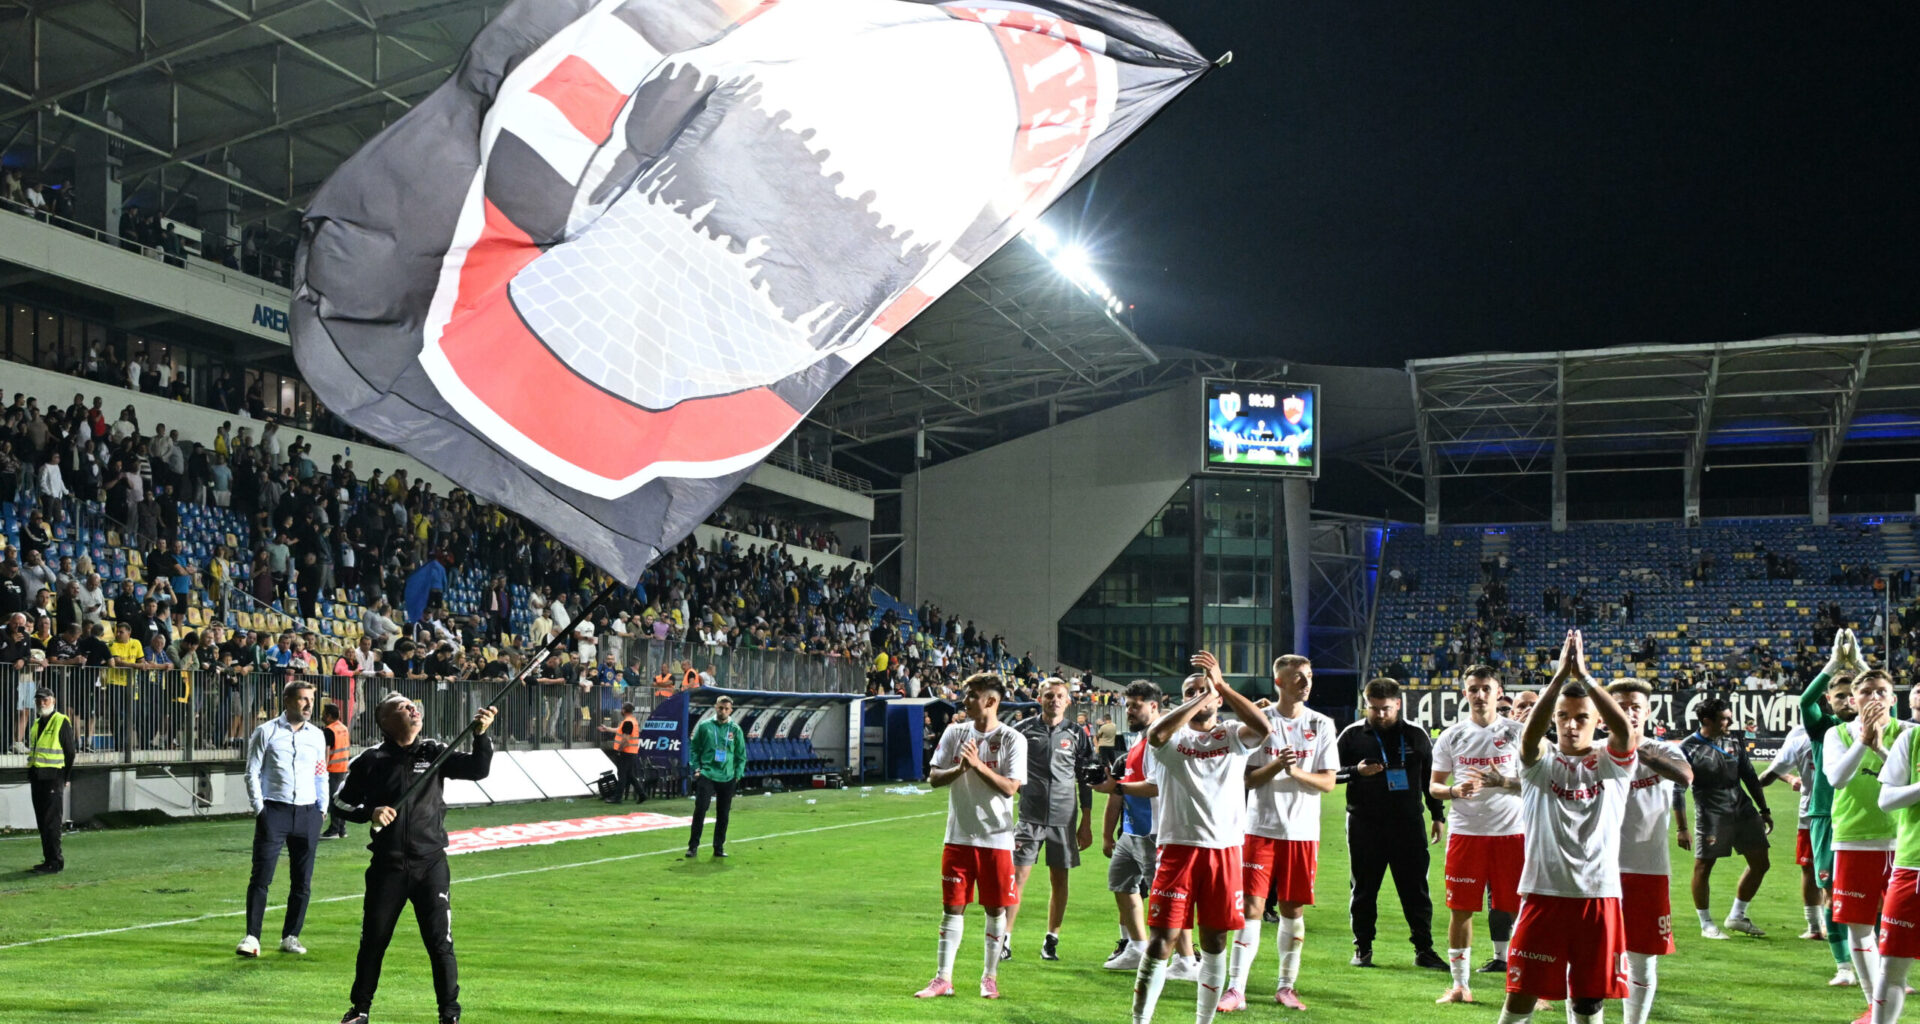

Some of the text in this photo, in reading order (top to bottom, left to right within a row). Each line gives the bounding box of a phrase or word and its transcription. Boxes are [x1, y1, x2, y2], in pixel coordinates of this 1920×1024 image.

[1401, 691, 1433, 727] LA
[638, 736, 682, 751] MrBit
[1176, 743, 1230, 760] SUPERBET
[1517, 950, 1557, 963] ALLVIEW
